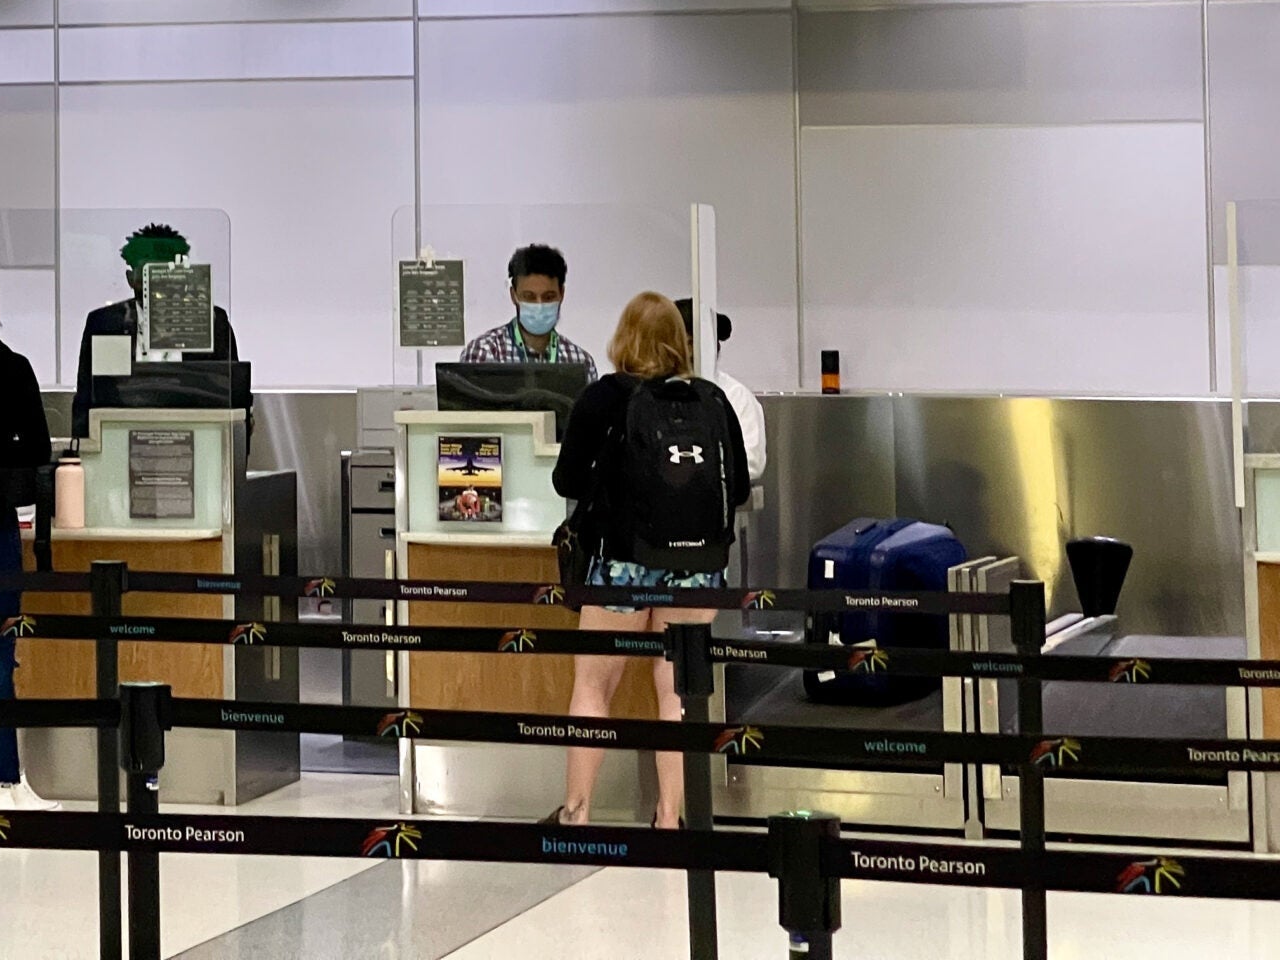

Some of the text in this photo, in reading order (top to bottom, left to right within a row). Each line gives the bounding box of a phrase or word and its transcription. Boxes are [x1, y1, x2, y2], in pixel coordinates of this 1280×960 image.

[400, 585, 467, 596] Toronto Pearson
[632, 592, 673, 602] welcome
[845, 596, 918, 607] Toronto Pearson
[110, 624, 155, 635] welcome
[341, 631, 421, 644] Toronto Pearson
[615, 638, 664, 651] bienvenu
[725, 646, 767, 660] Pearson
[972, 661, 1023, 673] welcome
[1238, 667, 1280, 680] Toronto
[221, 709, 284, 724] bienvenue
[518, 722, 617, 741] Toronto Pearson
[864, 738, 926, 754] welcome
[1187, 747, 1240, 762] Toronto
[124, 824, 244, 842] Toronto Pearson
[542, 836, 628, 857] bienvenue
[851, 851, 985, 876] Toronto Pearson
